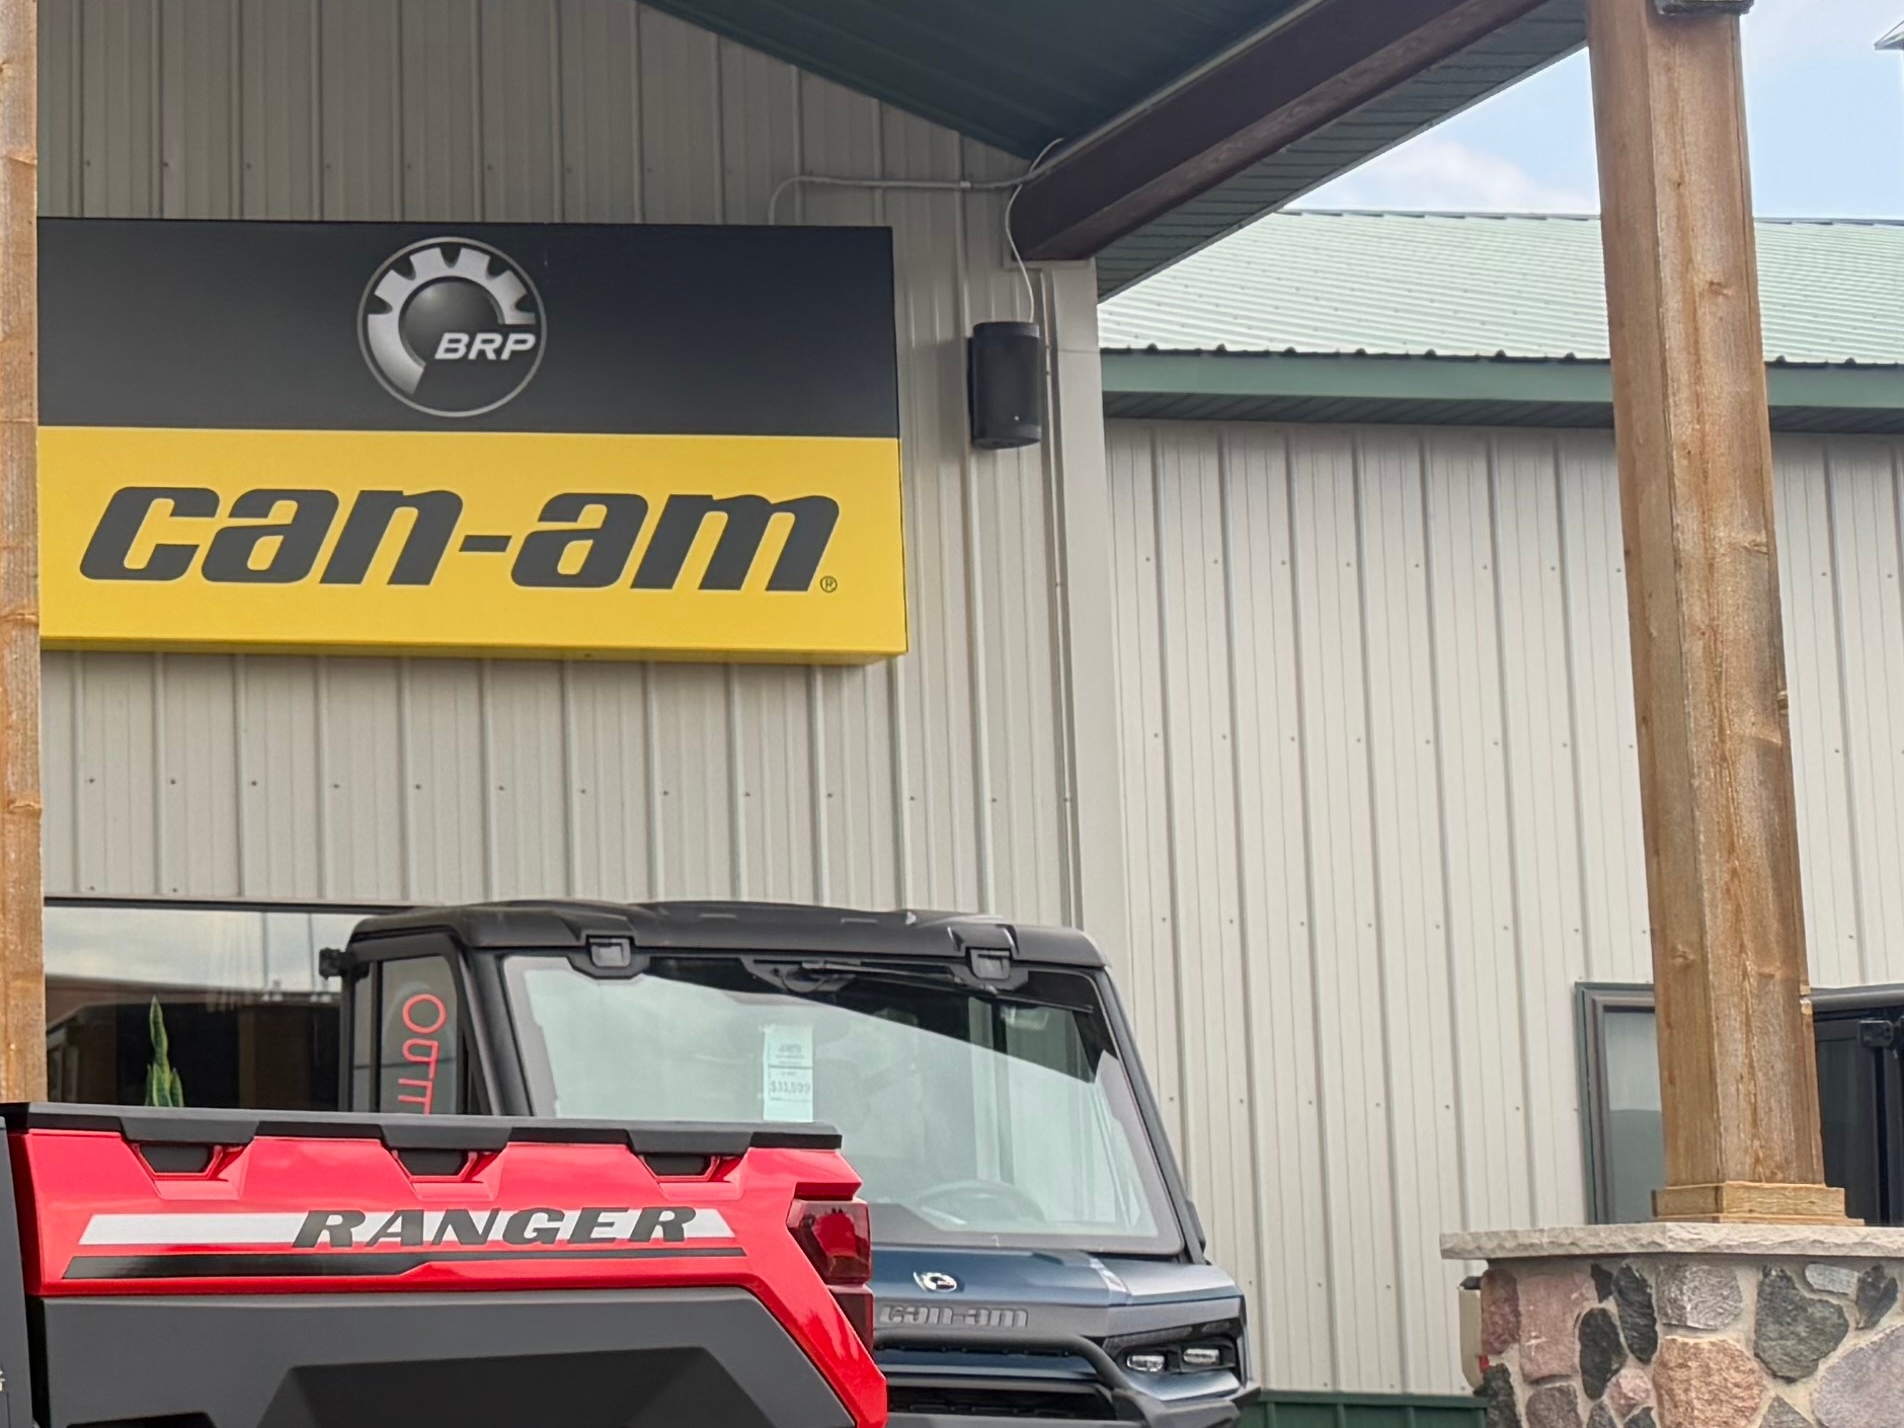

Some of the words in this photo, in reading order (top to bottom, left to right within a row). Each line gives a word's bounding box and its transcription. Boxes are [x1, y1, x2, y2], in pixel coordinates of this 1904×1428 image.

[433, 332, 537, 361] BRP
[292, 1206, 698, 1249] RANGER
[880, 1304, 1029, 1327] can-am
